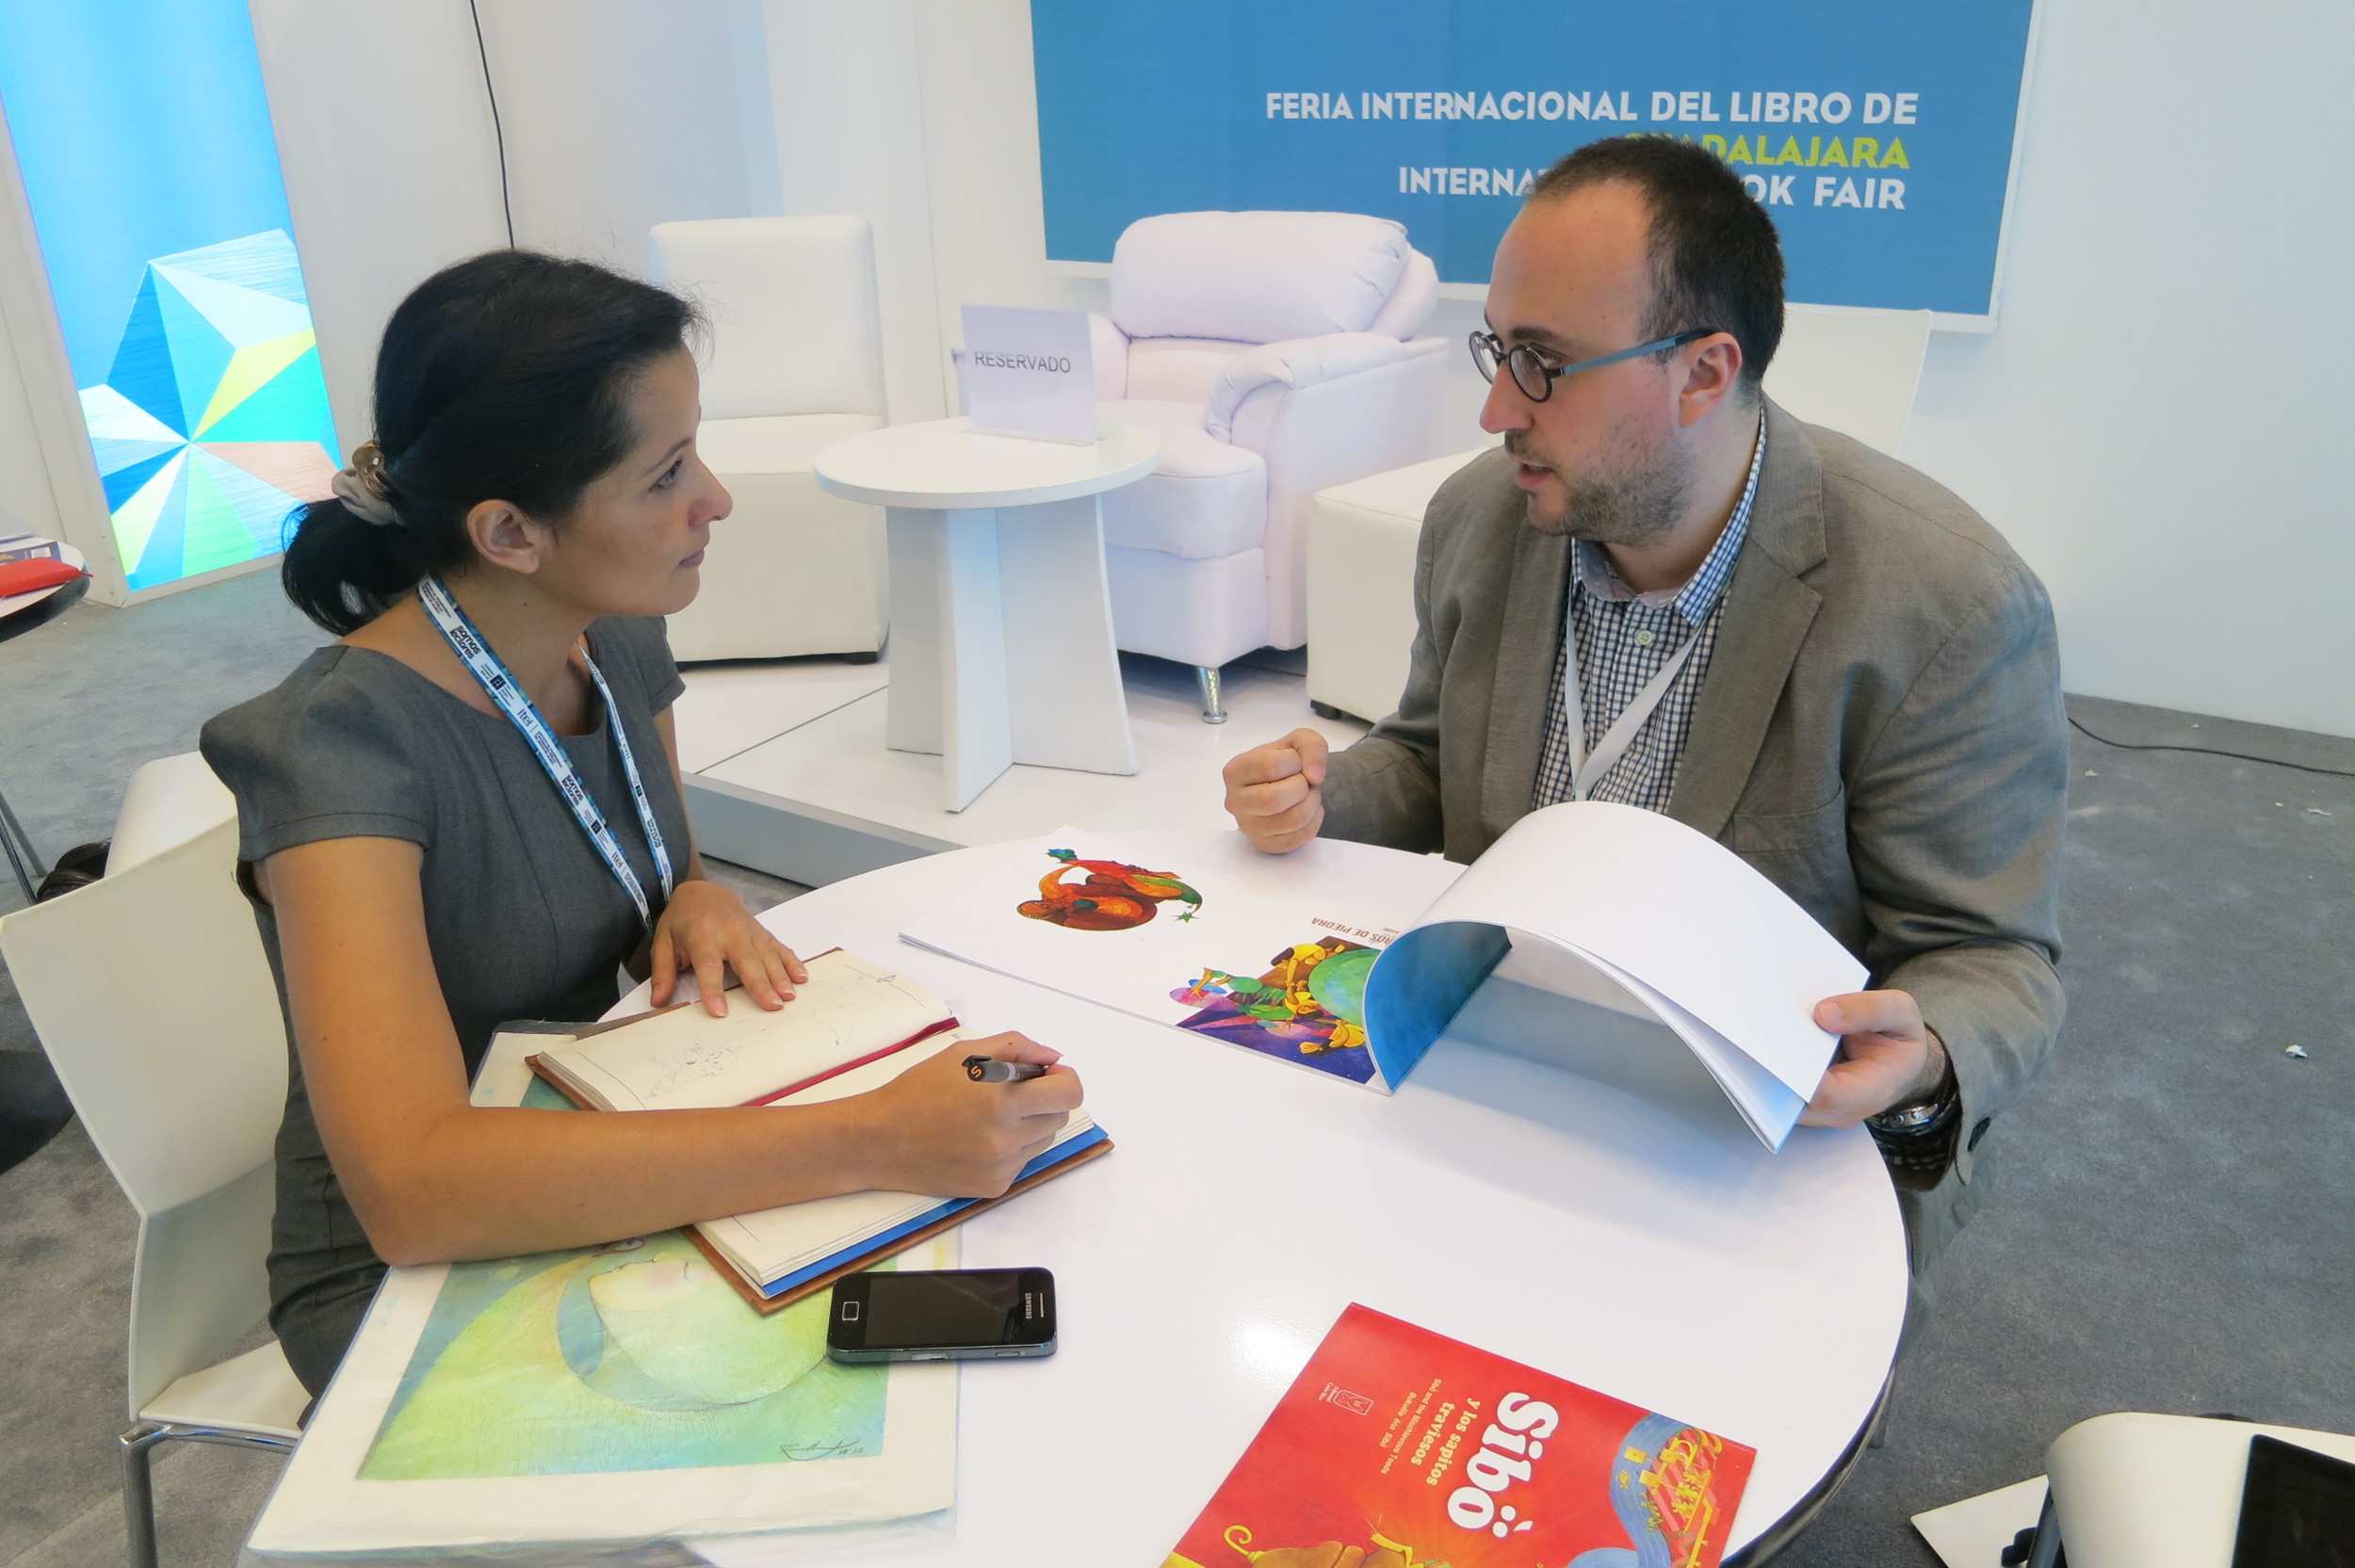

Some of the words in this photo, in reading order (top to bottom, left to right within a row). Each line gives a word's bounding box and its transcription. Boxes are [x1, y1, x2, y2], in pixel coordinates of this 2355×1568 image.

[1266, 91, 1354, 120] FERIA
[1361, 90, 1638, 121] INTERNACIONAL
[1650, 91, 1720, 121] DEL
[1730, 91, 1852, 124] LIBRO
[1862, 92, 1919, 124] DE
[1626, 132, 1910, 169] DALAJARA
[1399, 166, 1548, 197] INTERNA
[1743, 174, 1795, 206] OK
[1813, 176, 1906, 210] FAIR
[974, 350, 1071, 374] RESERVADO
[449, 628, 475, 659] lectores
[457, 625, 481, 655] somos
[1311, 916, 1353, 933] PIEDRA
[1353, 928, 1370, 938] DE
[1467, 1398, 1481, 1410] y
[1393, 1414, 1421, 1453] Mischievous
[1410, 1401, 1455, 1465] traviesos
[1455, 1410, 1477, 1432] los
[1380, 1454, 1398, 1474] Toads
[1425, 1432, 1461, 1486] sapitos
